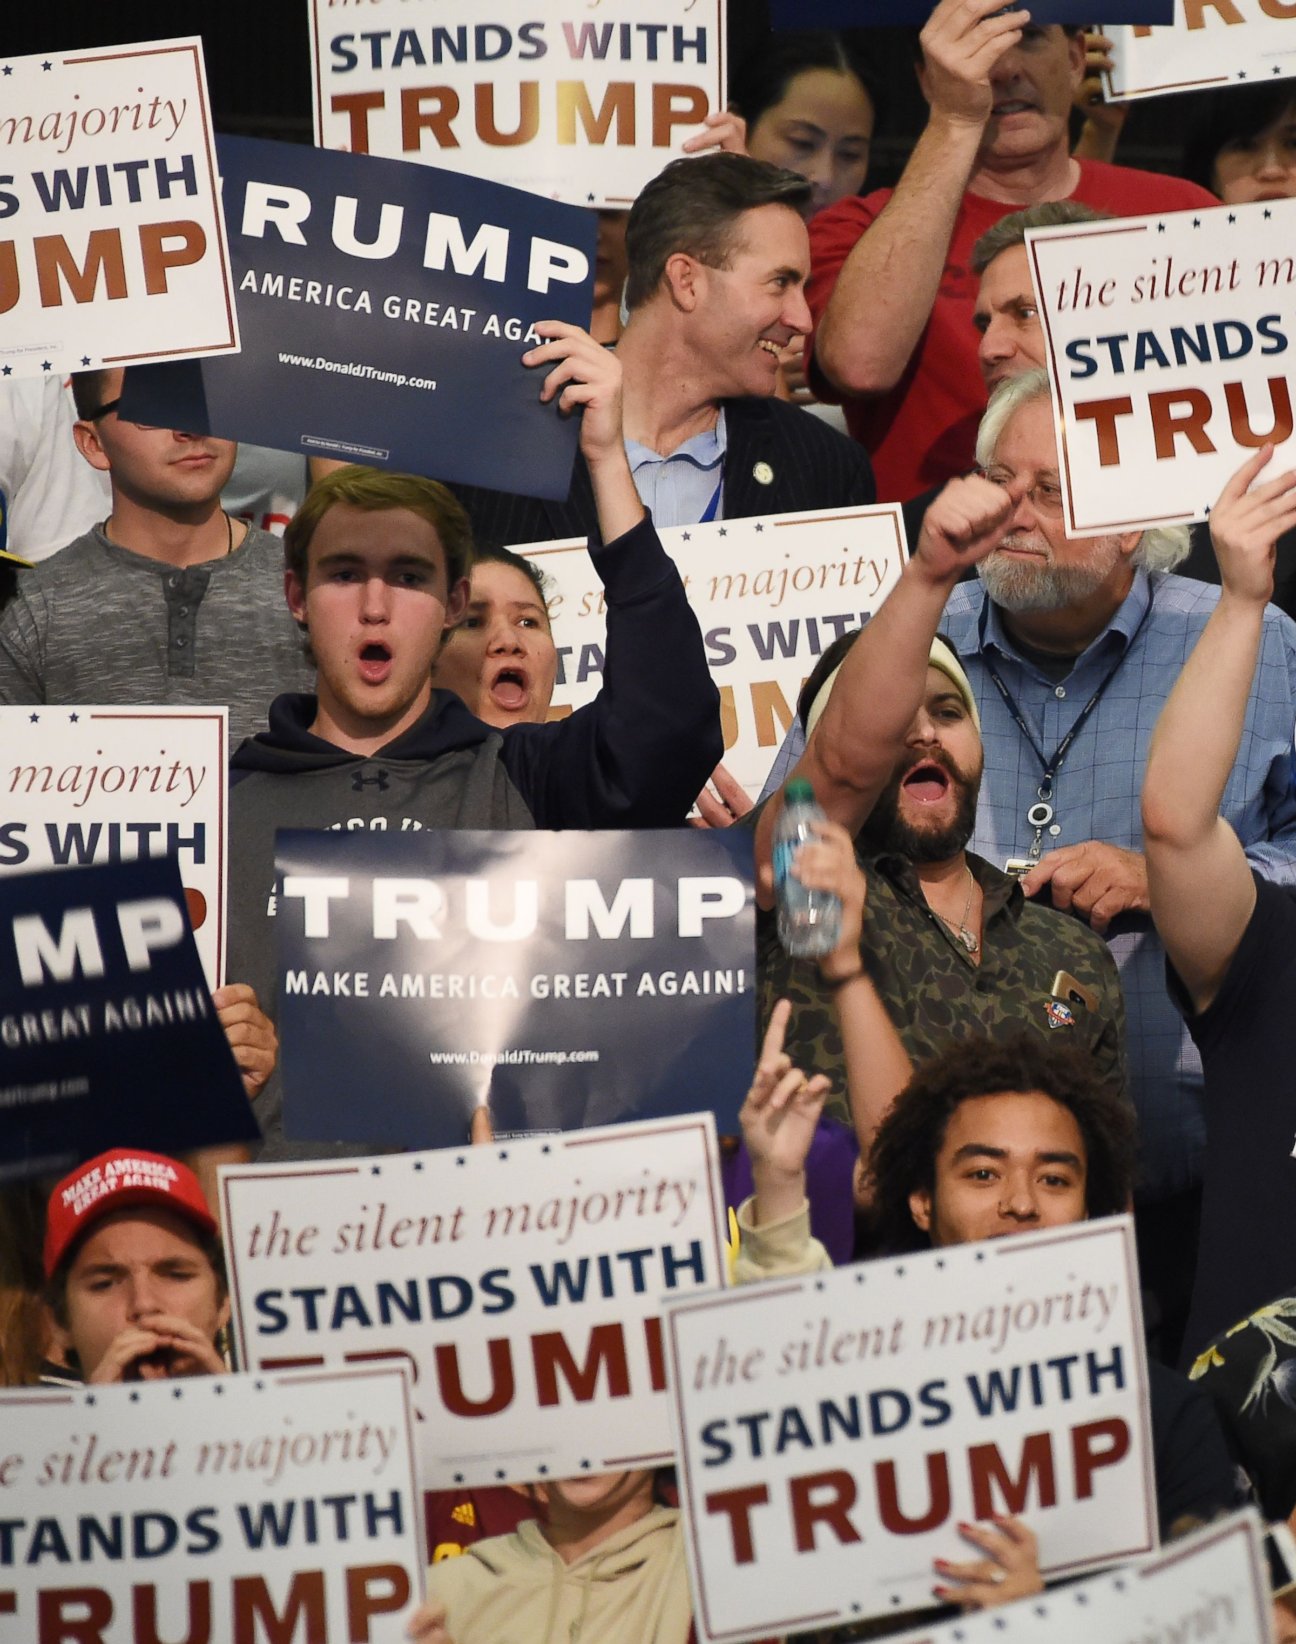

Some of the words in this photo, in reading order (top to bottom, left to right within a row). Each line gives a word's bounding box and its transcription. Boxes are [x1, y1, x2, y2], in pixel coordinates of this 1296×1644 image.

[330, 22, 548, 74] STANDS
[561, 22, 707, 65] WITH
[331, 80, 709, 154] TRUMP
[31, 154, 199, 213] WITH
[219, 177, 589, 294] RUMP
[240, 269, 373, 314] AMERICA
[383, 295, 476, 332] GREAT
[482, 314, 553, 345] AGA
[1056, 267, 1128, 312] the
[1130, 256, 1241, 305] silent
[278, 351, 437, 391] www.DonaldJTrump.com
[1064, 314, 1289, 379] STANDS
[708, 547, 889, 608] majority
[747, 611, 874, 661] WIT
[9, 750, 206, 808] majority
[44, 822, 206, 865] WITH
[284, 876, 745, 942] TRUMP
[285, 971, 369, 997] MAKE
[379, 970, 519, 998] AMERICA
[531, 972, 627, 998] GREAT
[637, 969, 746, 996] AGAIN!
[430, 1049, 599, 1065] www.DonaldJTrump.com
[61, 1167, 102, 1208] MAKE
[104, 1158, 178, 1182] AMERICA
[246, 1210, 319, 1259] the
[333, 1203, 465, 1257] silent
[485, 1170, 696, 1245] majority
[253, 1268, 516, 1336] STANDS
[529, 1240, 706, 1307] WITH
[692, 1338, 767, 1391] the
[775, 1318, 905, 1383] silent
[923, 1272, 1119, 1354] majority
[701, 1378, 954, 1468] STANDS
[967, 1345, 1127, 1417] WITH
[37, 1434, 178, 1488] silent
[195, 1411, 397, 1486] majority
[238, 1489, 403, 1549] WITH
[705, 1415, 1132, 1565] TRUMP
[0, 1563, 412, 1644] RUMP
